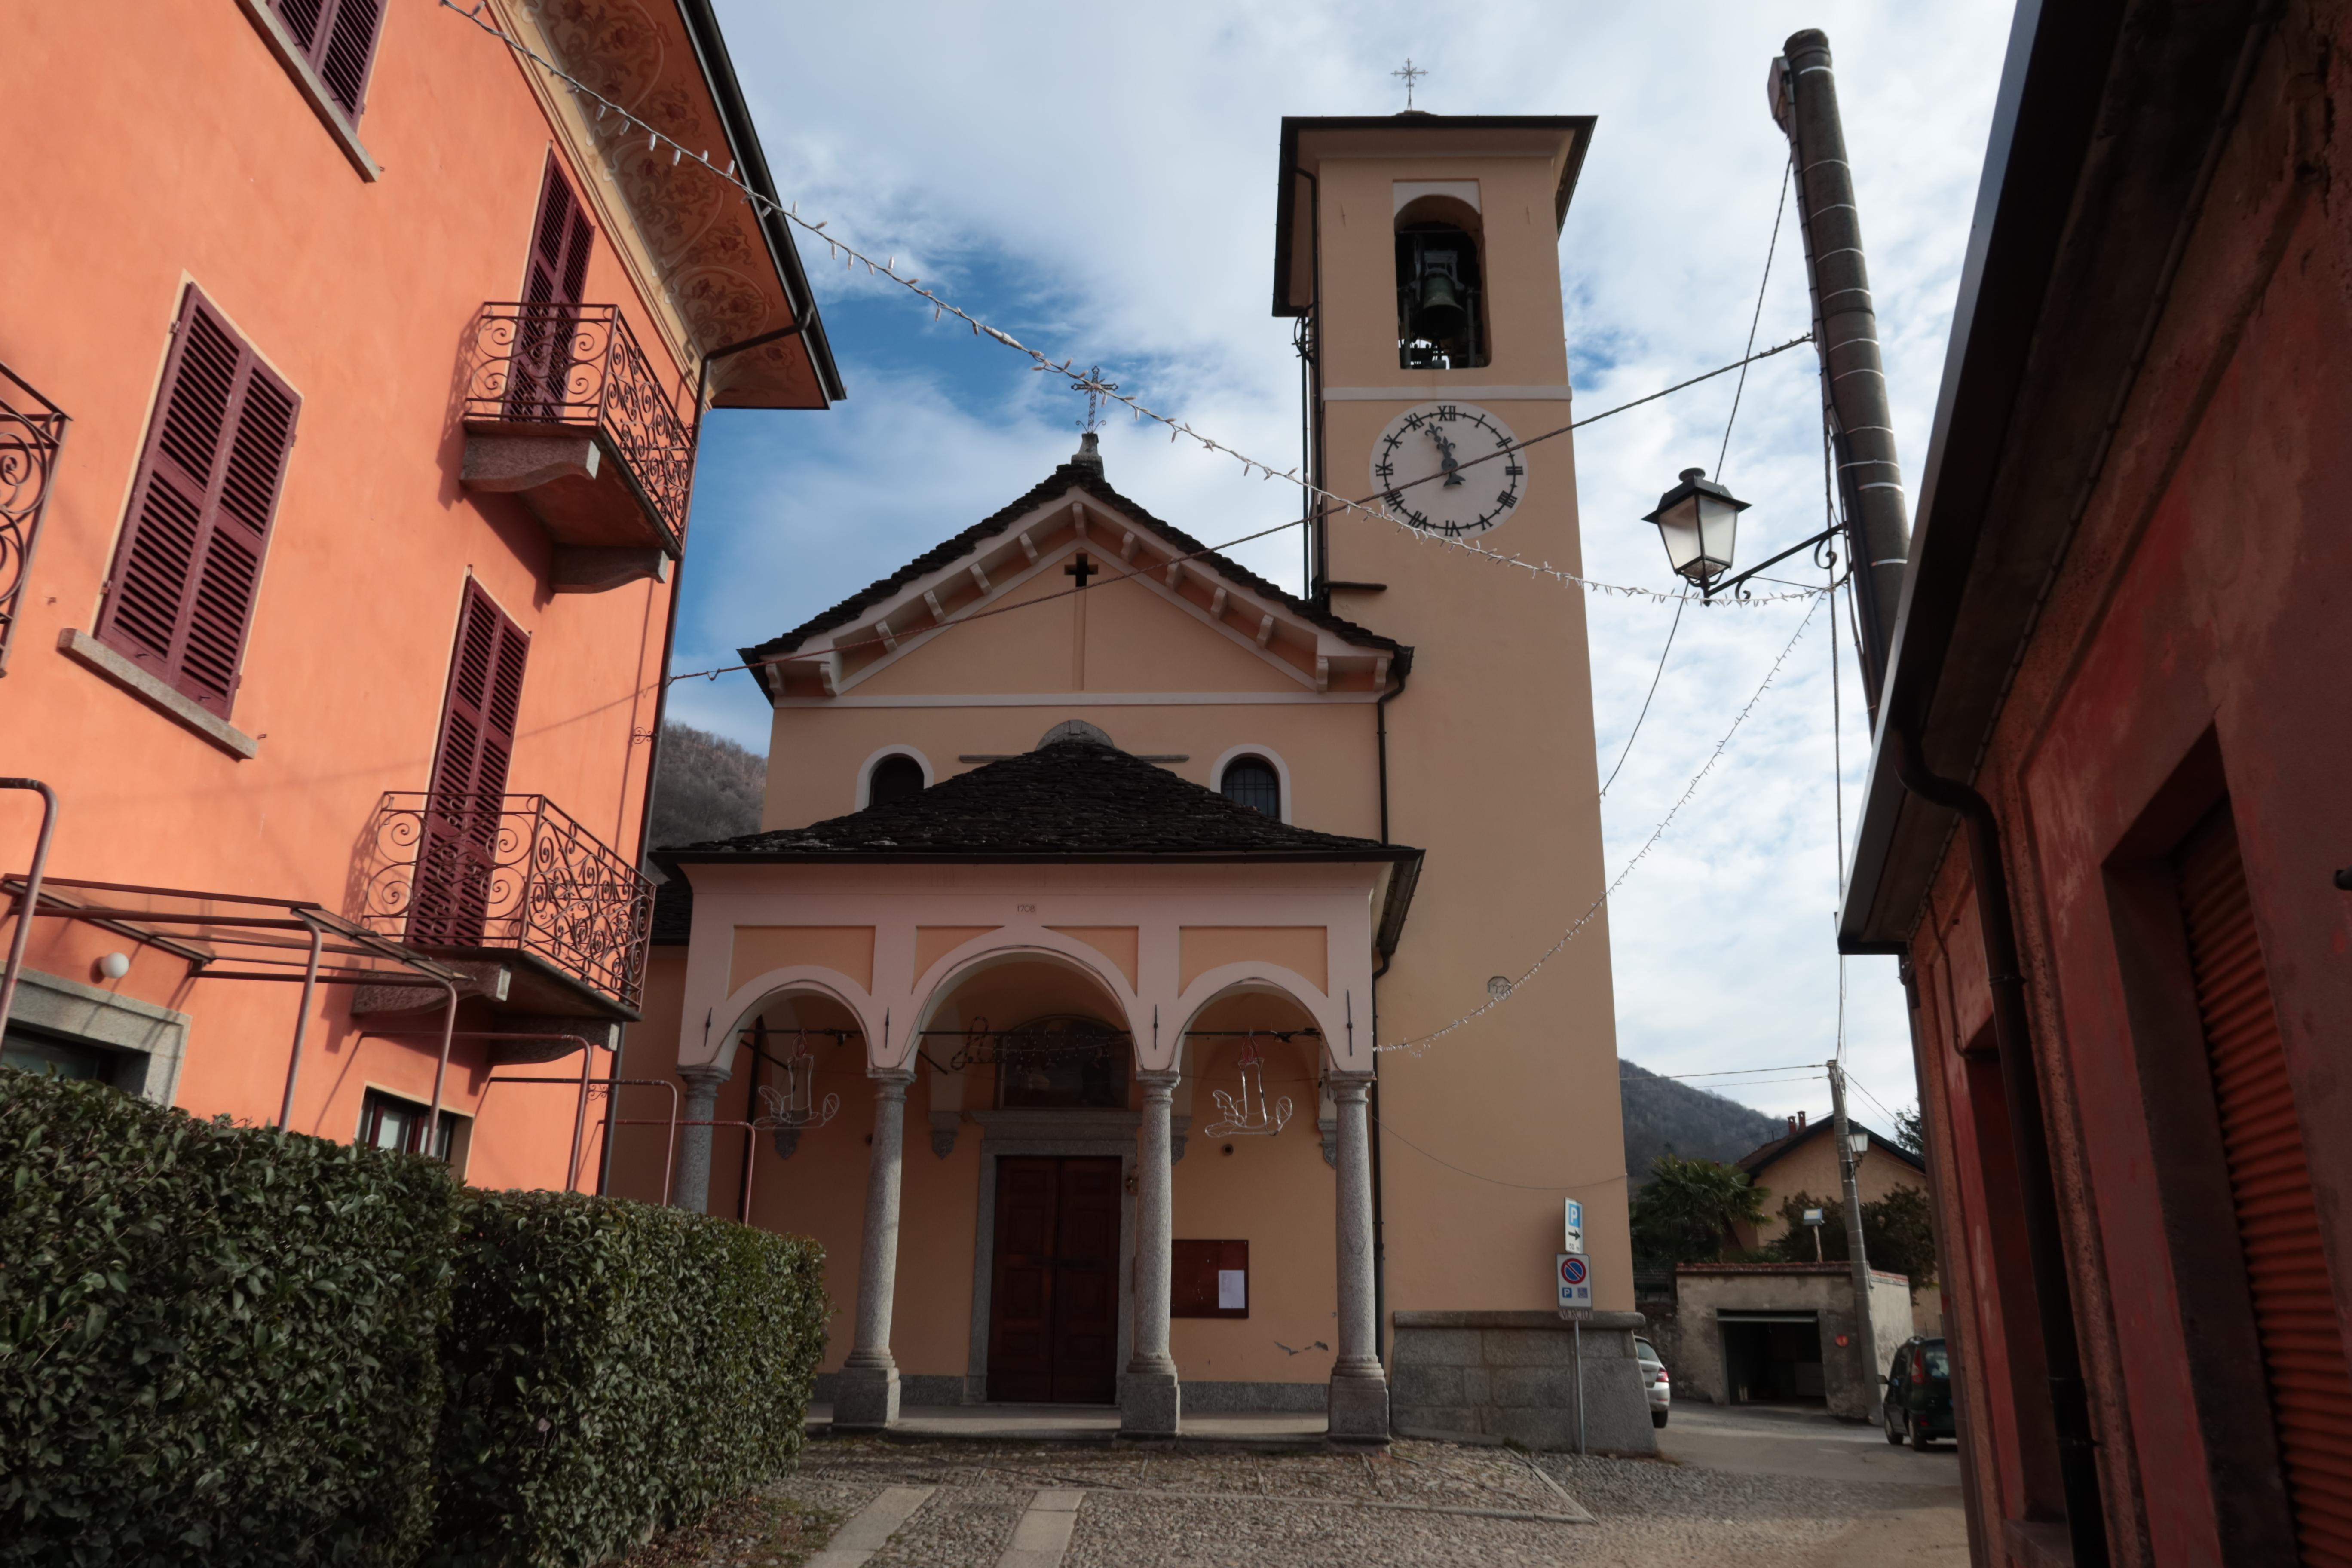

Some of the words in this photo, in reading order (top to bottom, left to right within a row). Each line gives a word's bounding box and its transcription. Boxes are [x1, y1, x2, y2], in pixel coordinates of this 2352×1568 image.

[1438, 406, 1456, 421] XII
[1475, 414, 1486, 428] I
[1404, 413, 1424, 431] XI
[1384, 434, 1402, 449] X
[1496, 437, 1512, 448] II
[1375, 463, 1393, 476] IX
[1506, 466, 1523, 475] III
[1497, 490, 1517, 508] IIII
[1409, 511, 1428, 531] VII
[1445, 520, 1461, 536] VI
[1480, 514, 1493, 530] V
[1570, 1207, 1578, 1224] P
[1564, 1289, 1570, 1297] P
